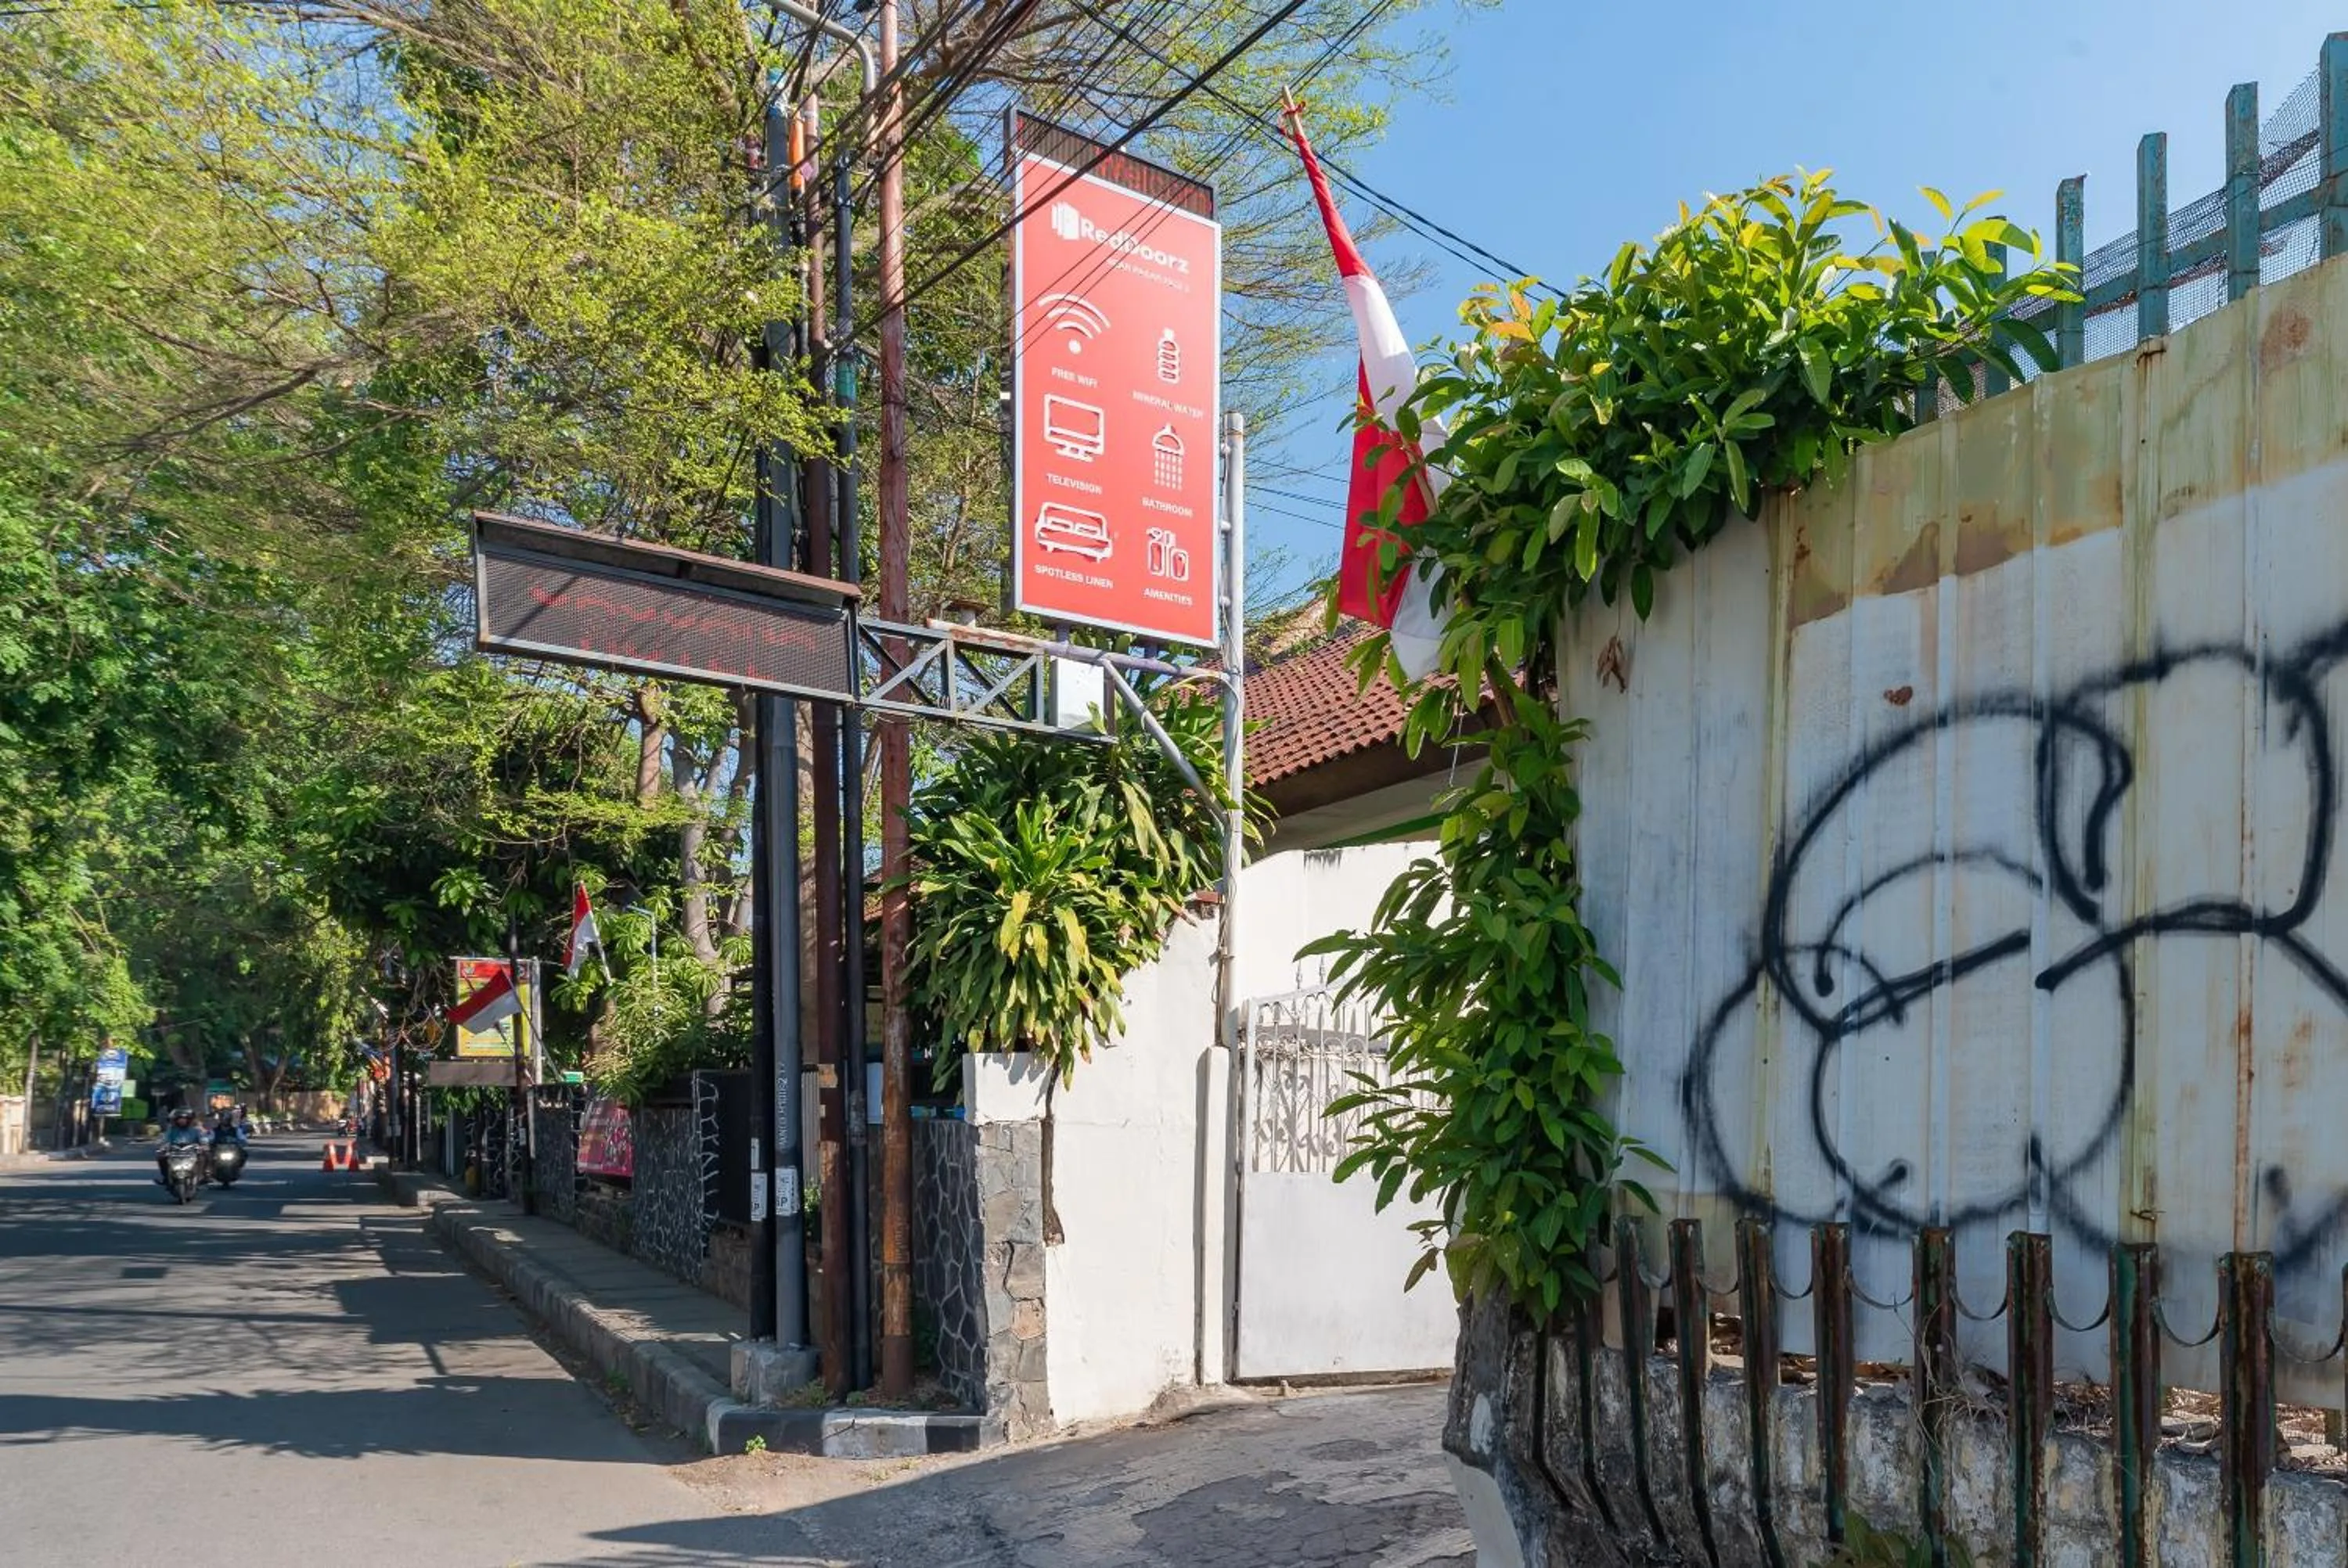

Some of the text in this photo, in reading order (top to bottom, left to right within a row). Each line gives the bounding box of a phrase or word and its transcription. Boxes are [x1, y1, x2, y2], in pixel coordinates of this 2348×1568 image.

[1051, 367, 1098, 388] FREE WIFI
[1133, 390, 1203, 419] MINERAL WATER
[1046, 473, 1102, 494] TELEVISION
[1142, 498, 1193, 518] BATHROOM
[1035, 563, 1113, 589] SPOTLESS LINEN
[1143, 588, 1193, 606] AMENITIES
